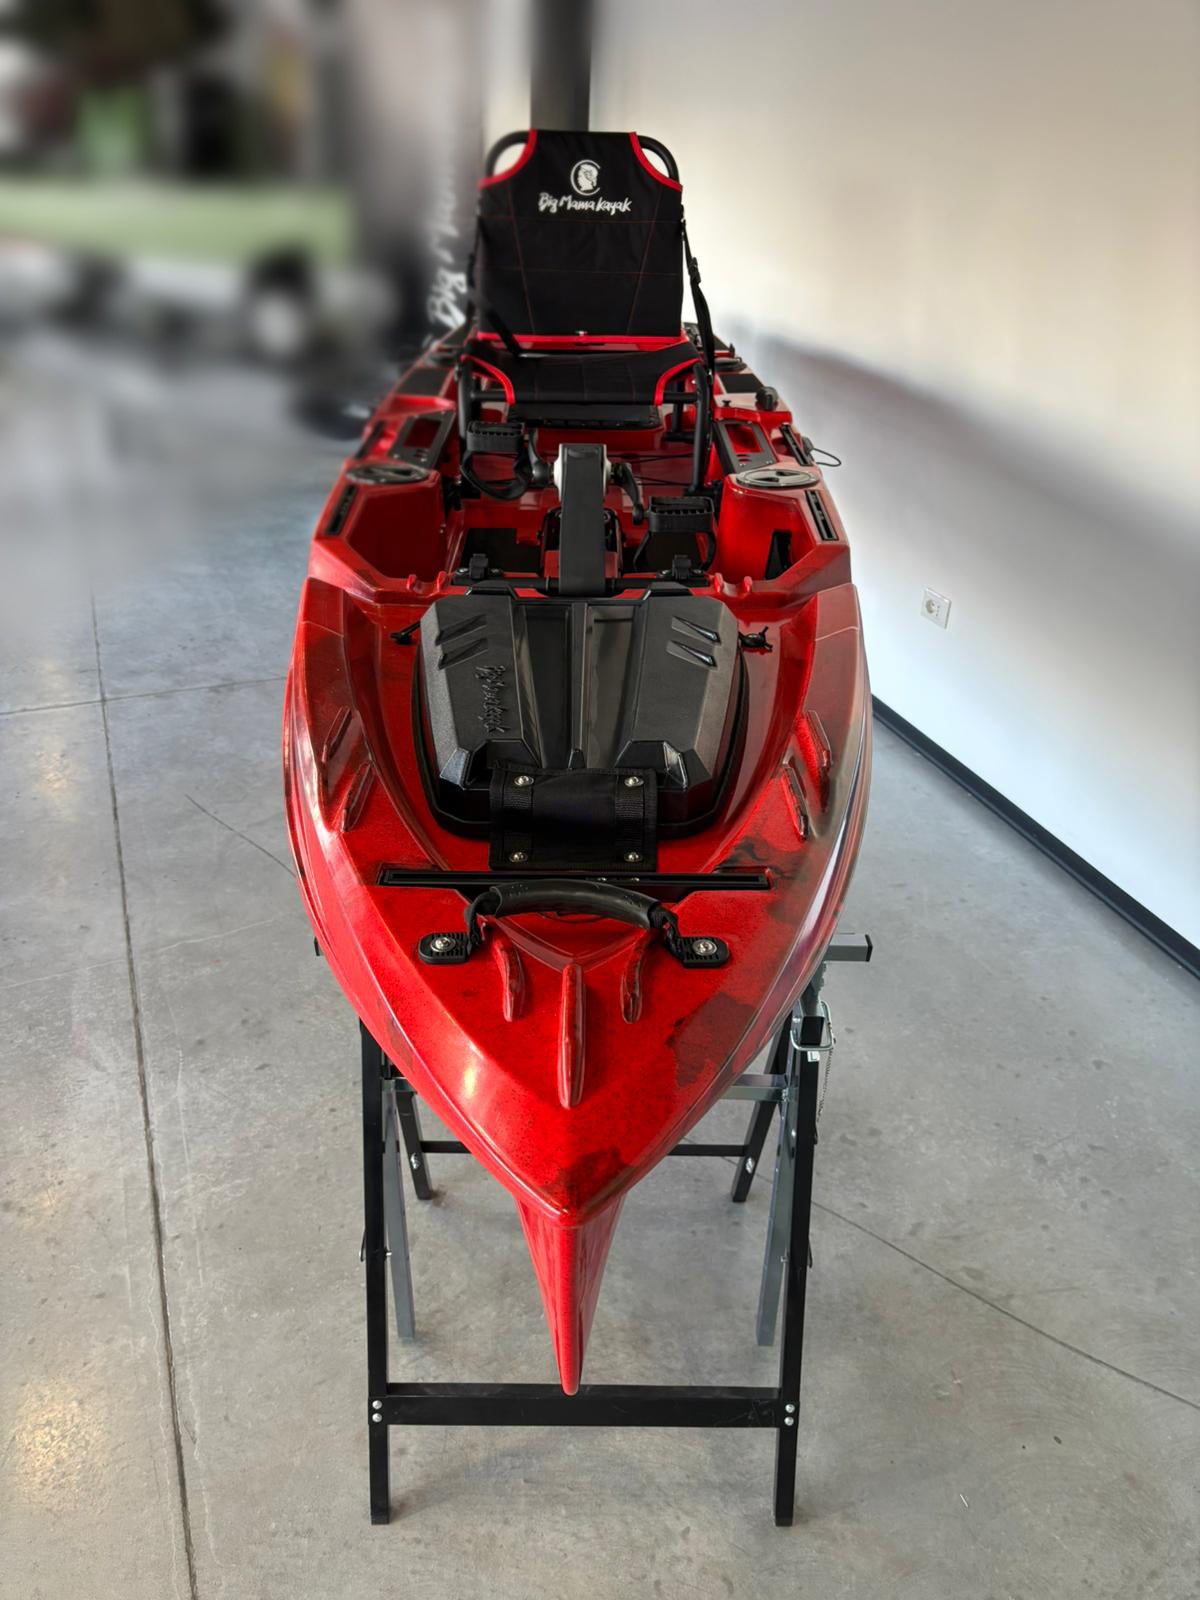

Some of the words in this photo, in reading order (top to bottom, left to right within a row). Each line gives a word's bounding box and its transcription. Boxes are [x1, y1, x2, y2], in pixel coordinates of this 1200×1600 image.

[538, 192, 558, 213] Big
[559, 195, 595, 210] Mama
[426, 268, 466, 328] Big
